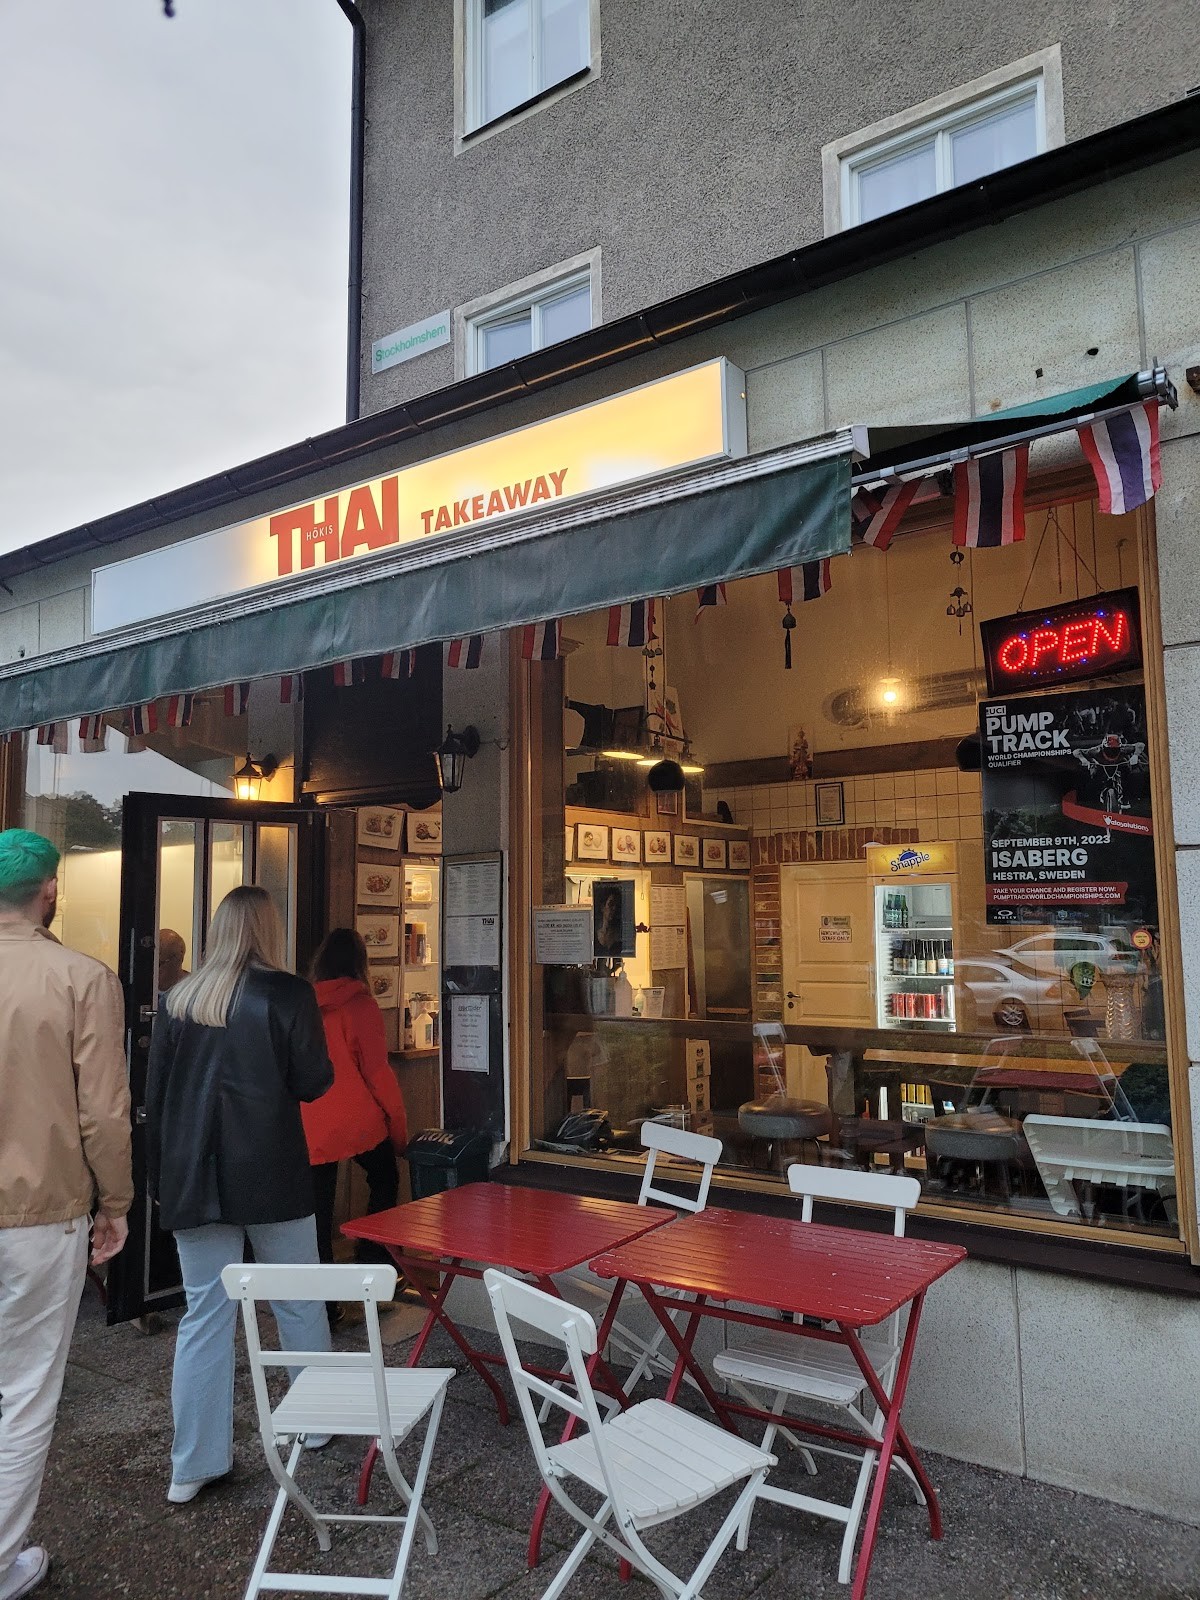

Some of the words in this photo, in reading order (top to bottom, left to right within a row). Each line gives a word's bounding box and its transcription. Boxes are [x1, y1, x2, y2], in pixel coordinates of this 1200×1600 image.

[375, 325, 447, 361] Stockholmshem
[421, 468, 568, 534] TAKEAWAY
[270, 475, 399, 576] THAI
[1000, 612, 1127, 672] OPEN
[989, 707, 1005, 715] UCI
[986, 712, 1054, 735] PUMP
[987, 729, 1070, 753] TRACK
[988, 760, 1021, 768] QUALIFIER
[1013, 749, 1071, 759] CHAMPIONSHIPS
[992, 837, 1053, 848] SEPTEMBER
[1055, 836, 1080, 847] 9TH,
[1081, 835, 1111, 845] 2023
[890, 852, 930, 872] Snapple
[992, 848, 1088, 868] ISABERG
[993, 872, 1038, 881] HESTRA,
[1039, 870, 1086, 880] SWEDEN
